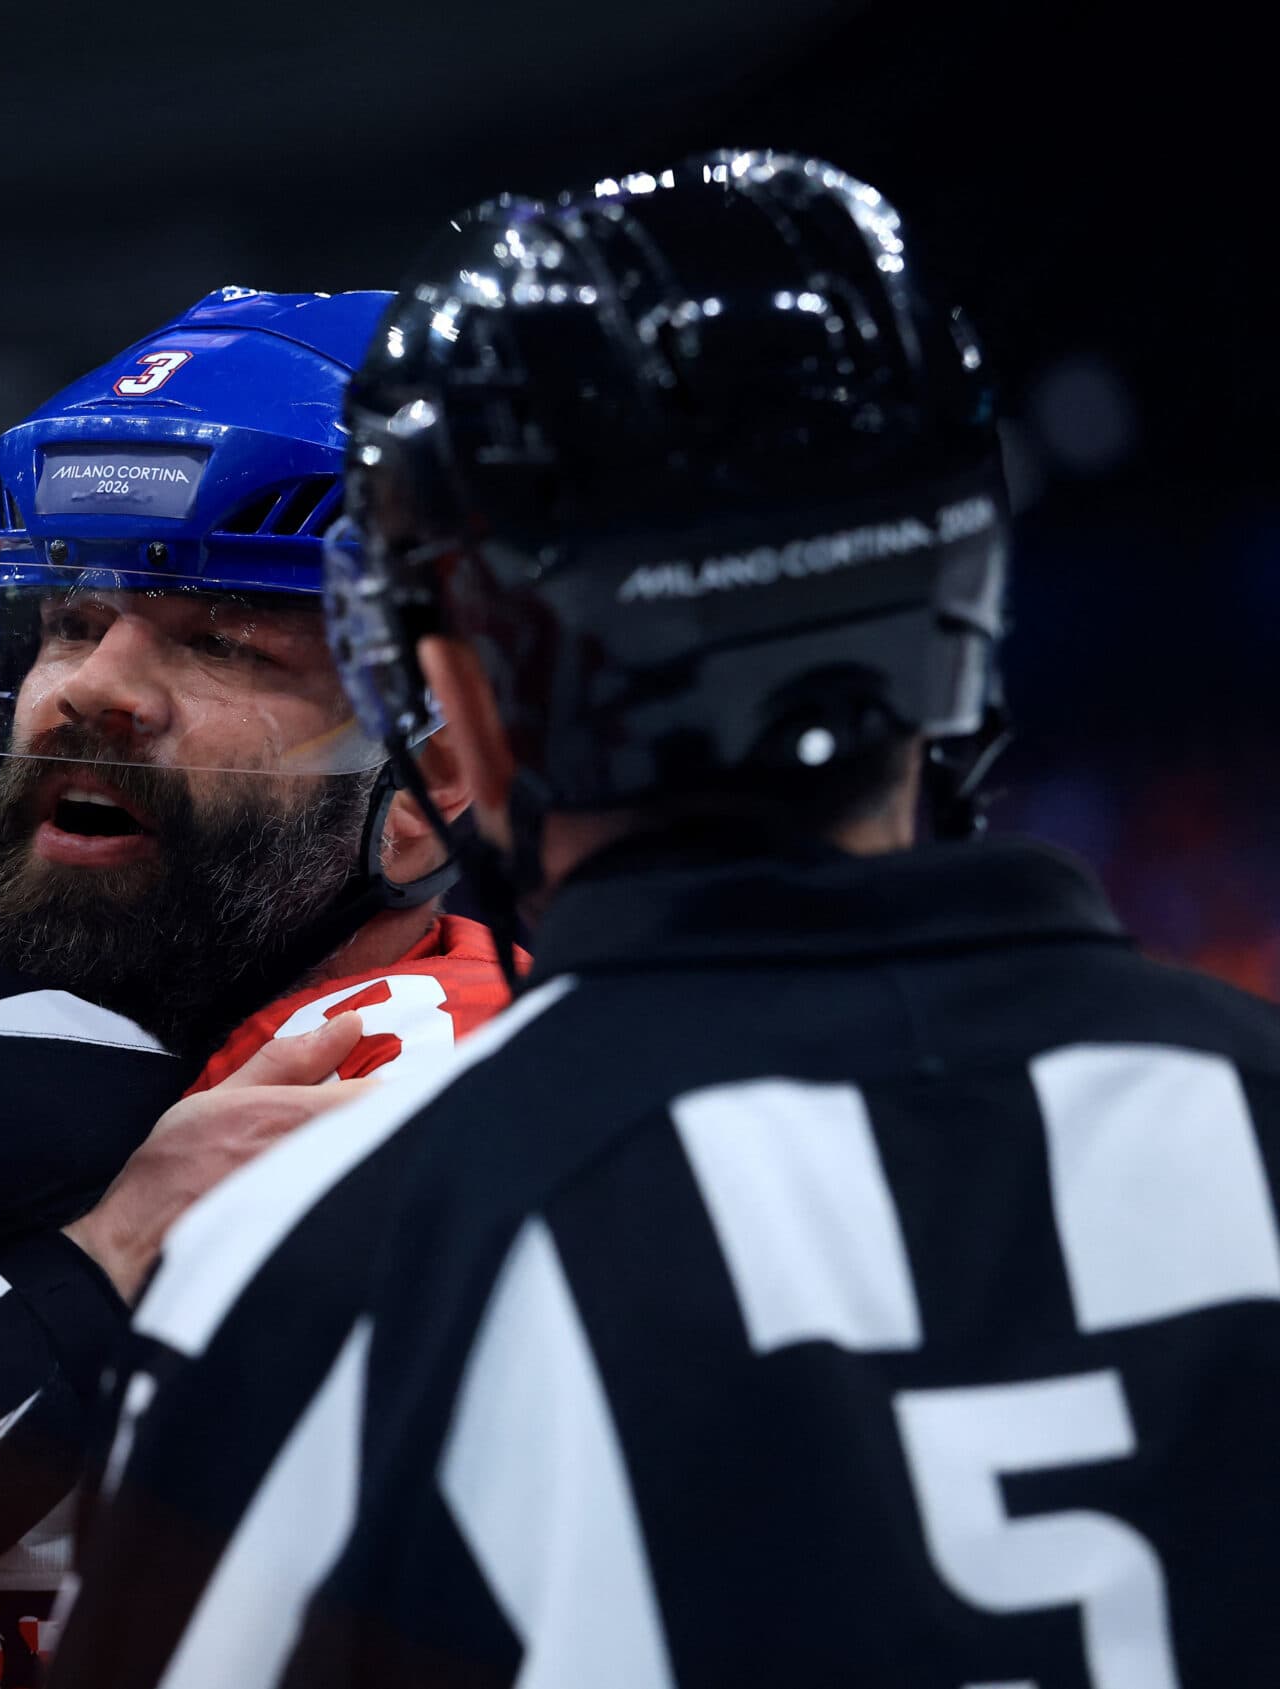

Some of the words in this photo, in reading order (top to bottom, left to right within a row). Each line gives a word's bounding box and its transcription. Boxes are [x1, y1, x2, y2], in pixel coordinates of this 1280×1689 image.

[113, 350, 193, 396] 3
[51, 465, 114, 479] MILANO
[117, 466, 190, 483] CORTINA
[96, 480, 129, 494] 2026
[892, 1367, 1182, 1689] 5
